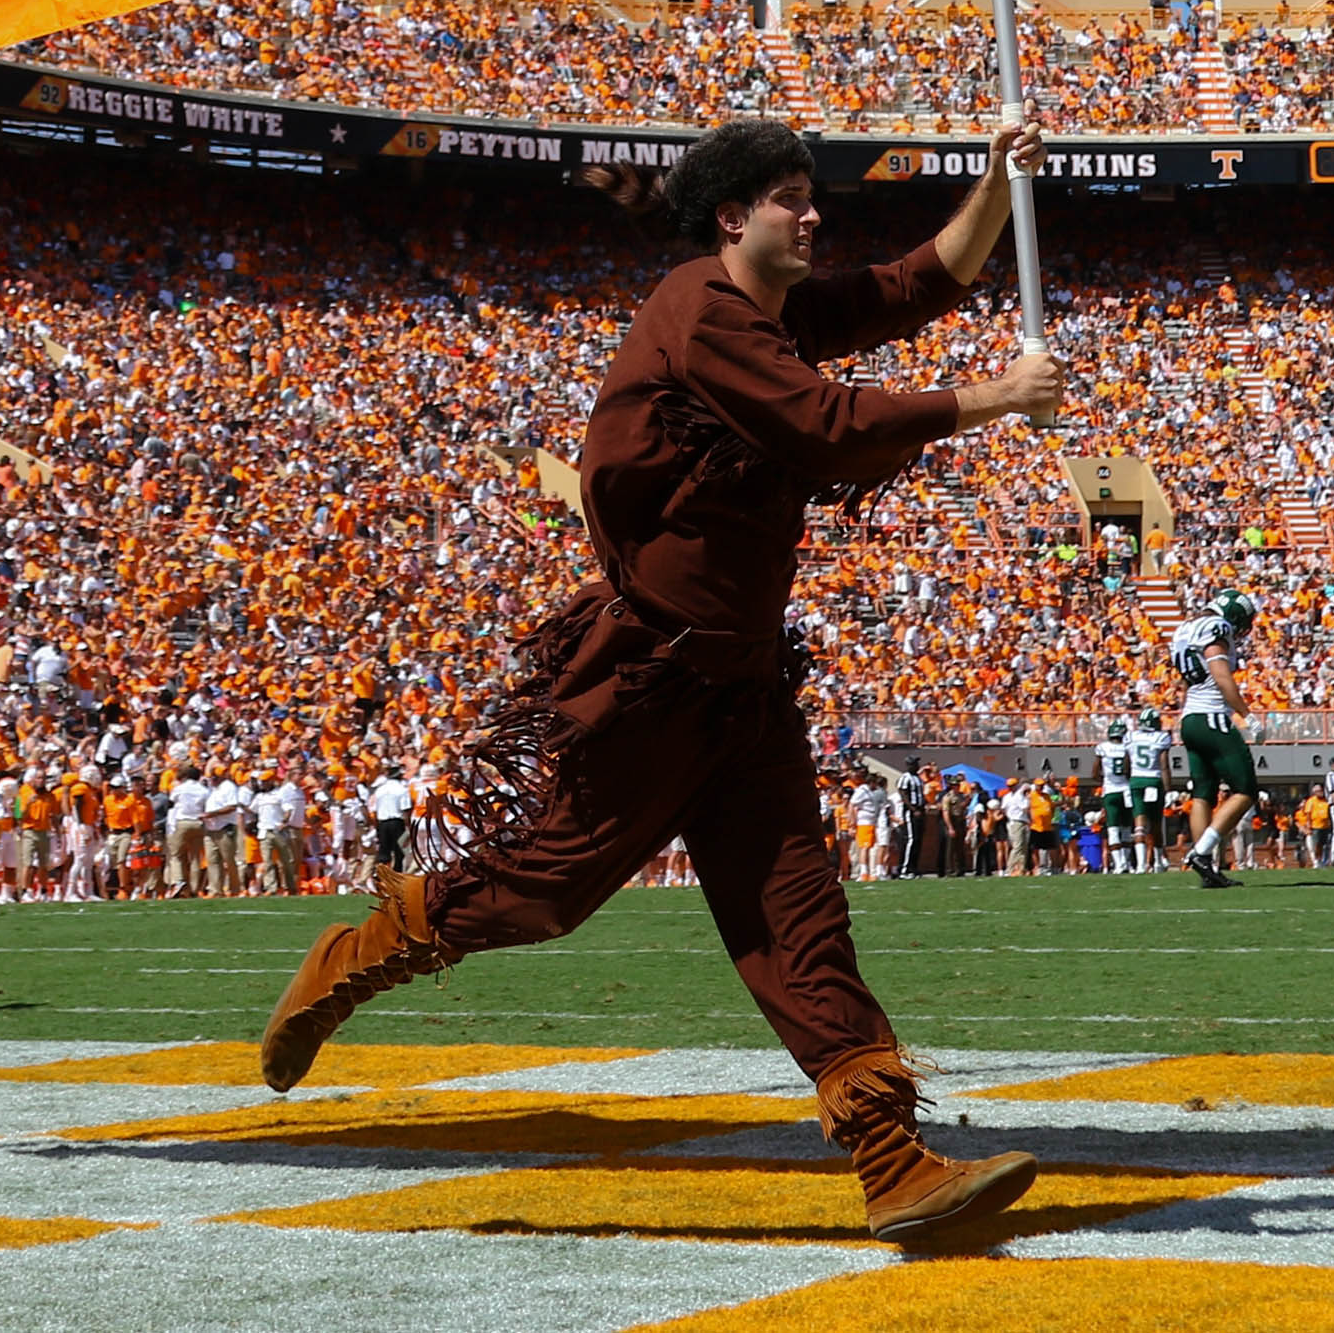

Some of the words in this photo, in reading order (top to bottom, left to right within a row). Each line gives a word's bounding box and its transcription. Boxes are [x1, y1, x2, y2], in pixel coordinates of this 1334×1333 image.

[39, 84, 60, 105] 92
[68, 84, 175, 123] REGGIE
[183, 101, 285, 138] WHITE
[406, 130, 428, 149] 16
[438, 129, 562, 162] PEYTON
[581, 140, 687, 166] MANN
[889, 155, 912, 172] 91
[921, 152, 988, 176] DOU
[1211, 150, 1243, 179] T
[1136, 745, 1151, 768] 5
